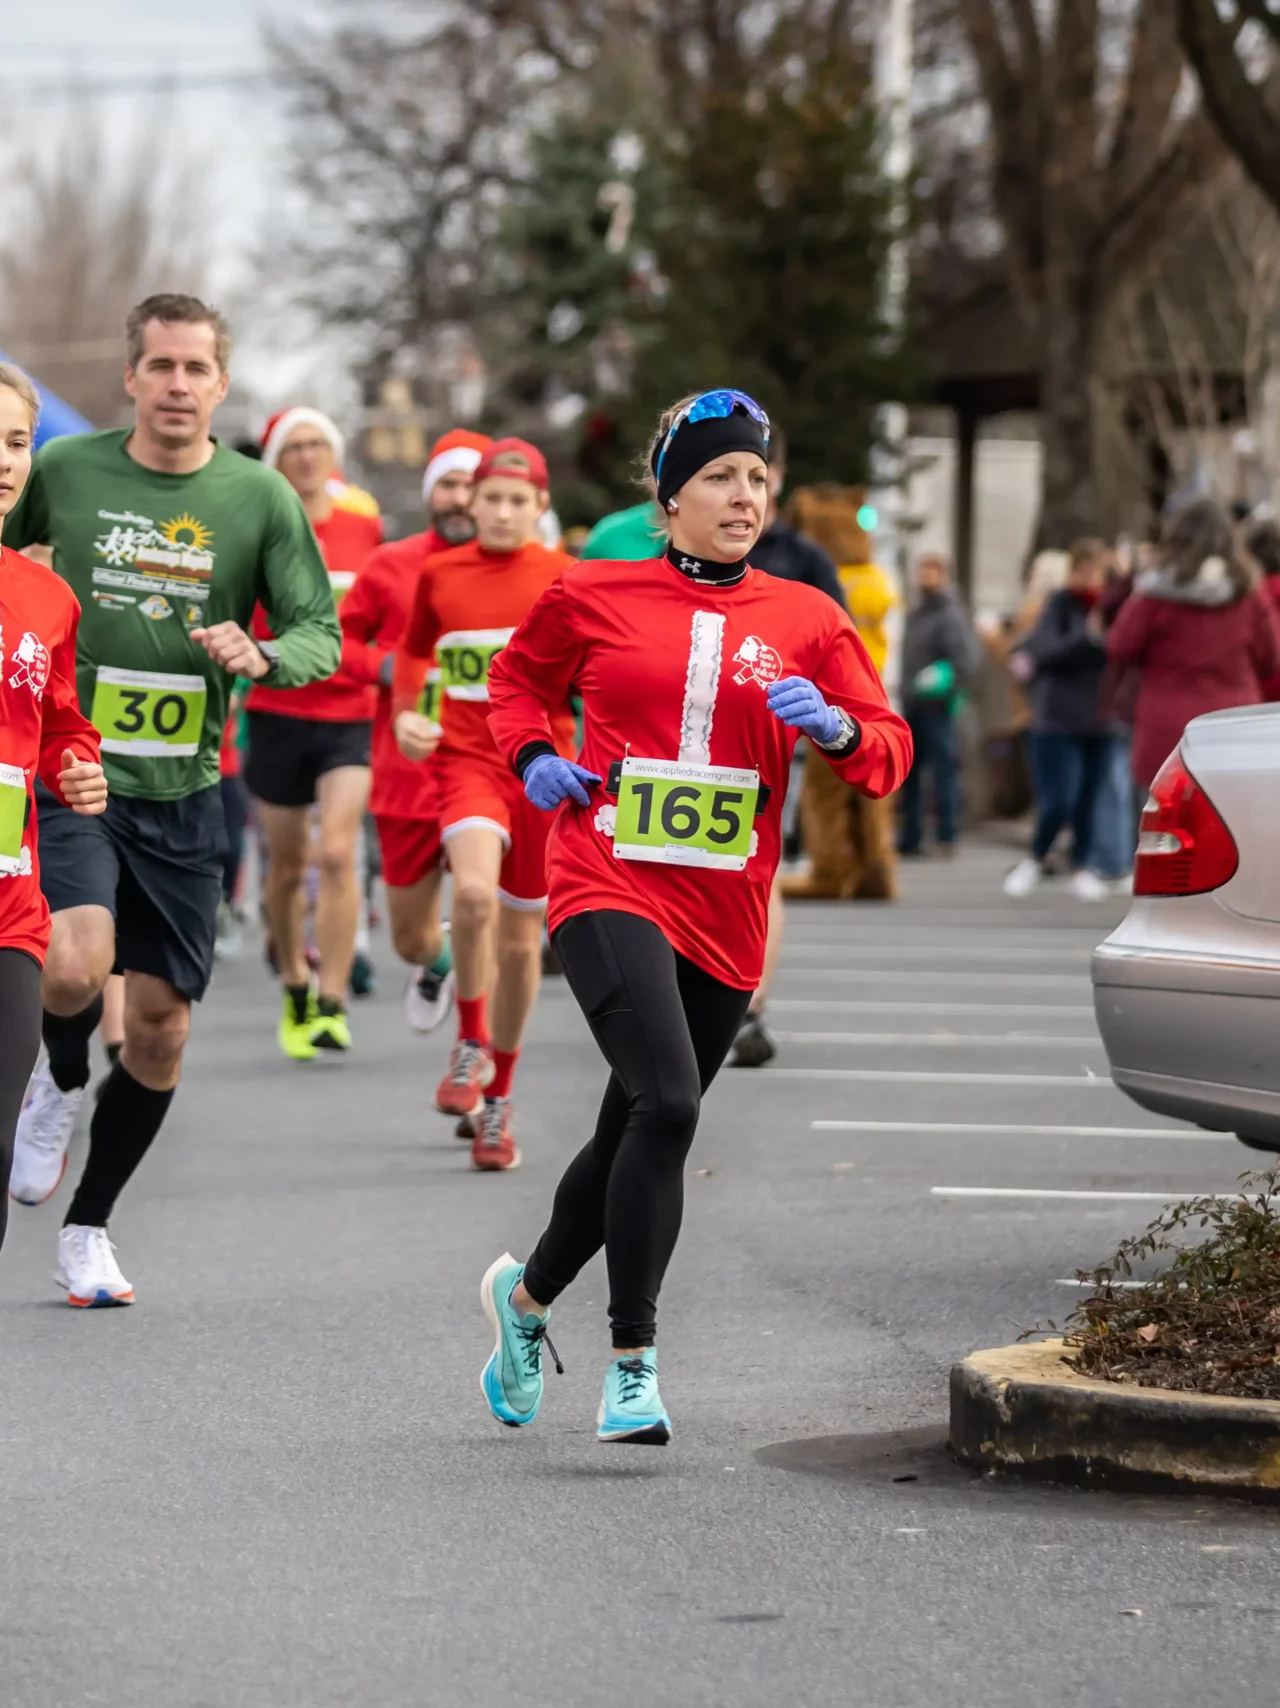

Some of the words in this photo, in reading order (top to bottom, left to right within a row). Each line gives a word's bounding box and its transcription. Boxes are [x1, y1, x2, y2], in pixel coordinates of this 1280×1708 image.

[113, 690, 188, 737] 30
[634, 763, 751, 784] www.appliedracemgmt.com
[631, 782, 744, 845] 165
